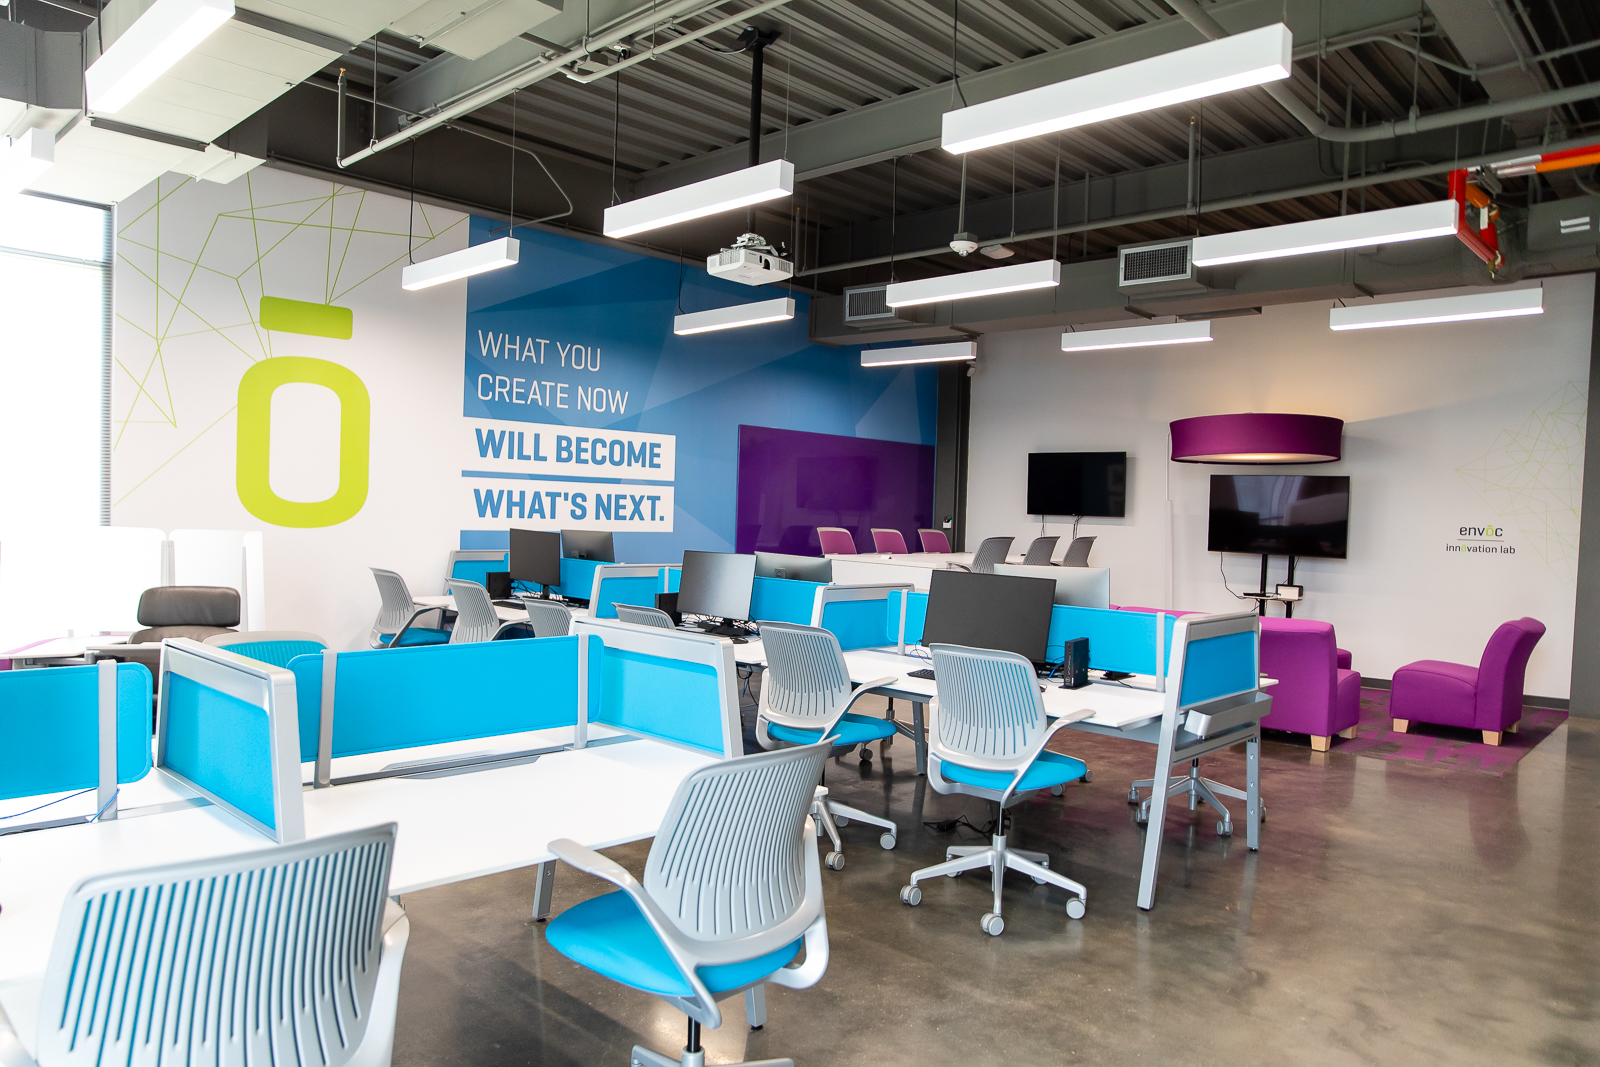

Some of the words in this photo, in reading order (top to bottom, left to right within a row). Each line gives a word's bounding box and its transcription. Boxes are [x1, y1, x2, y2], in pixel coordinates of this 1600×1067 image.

[478, 329, 550, 365] WHAT
[556, 341, 601, 372] YOU
[477, 373, 570, 409] CREATE
[577, 385, 629, 415] NOW
[475, 428, 548, 462] WILL
[556, 434, 662, 469] BECOME
[473, 488, 588, 520] WHAT'S
[594, 493, 665, 522] NEXT.
[1500, 545, 1516, 554] lab
